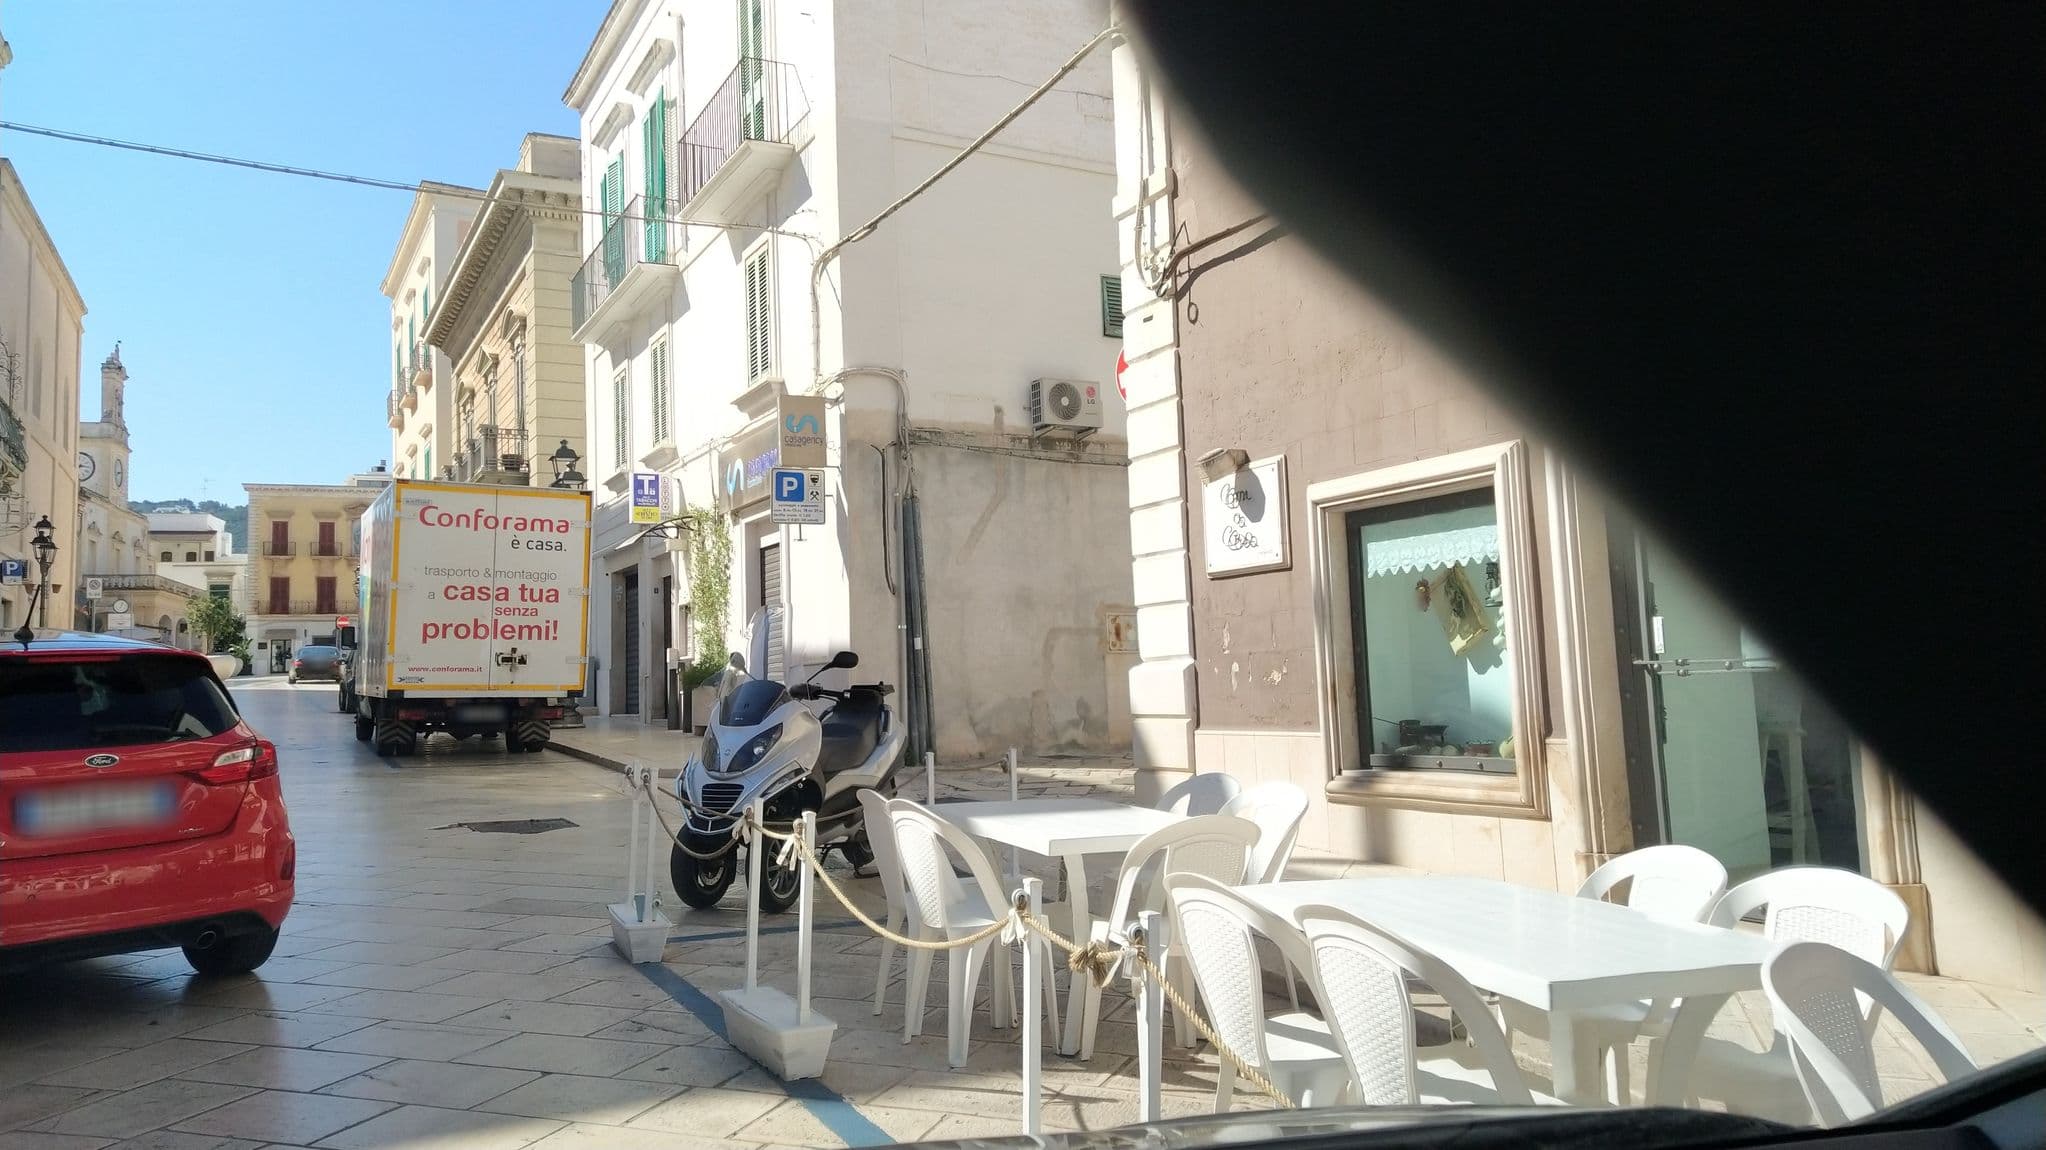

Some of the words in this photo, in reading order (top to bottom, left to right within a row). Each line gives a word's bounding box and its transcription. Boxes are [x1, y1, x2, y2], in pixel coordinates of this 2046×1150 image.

[782, 476, 798, 498] P
[419, 505, 570, 534] Conforama
[511, 534, 520, 550] è
[526, 539, 567, 552] casa.
[6, 561, 18, 575] P
[424, 566, 479, 578] trasporto
[484, 568, 491, 578] &
[495, 568, 557, 582] montaggio
[428, 592, 435, 600] a
[444, 584, 510, 601] casa
[519, 584, 560, 603] tua
[494, 606, 538, 616] senza
[422, 618, 558, 644] problemi!
